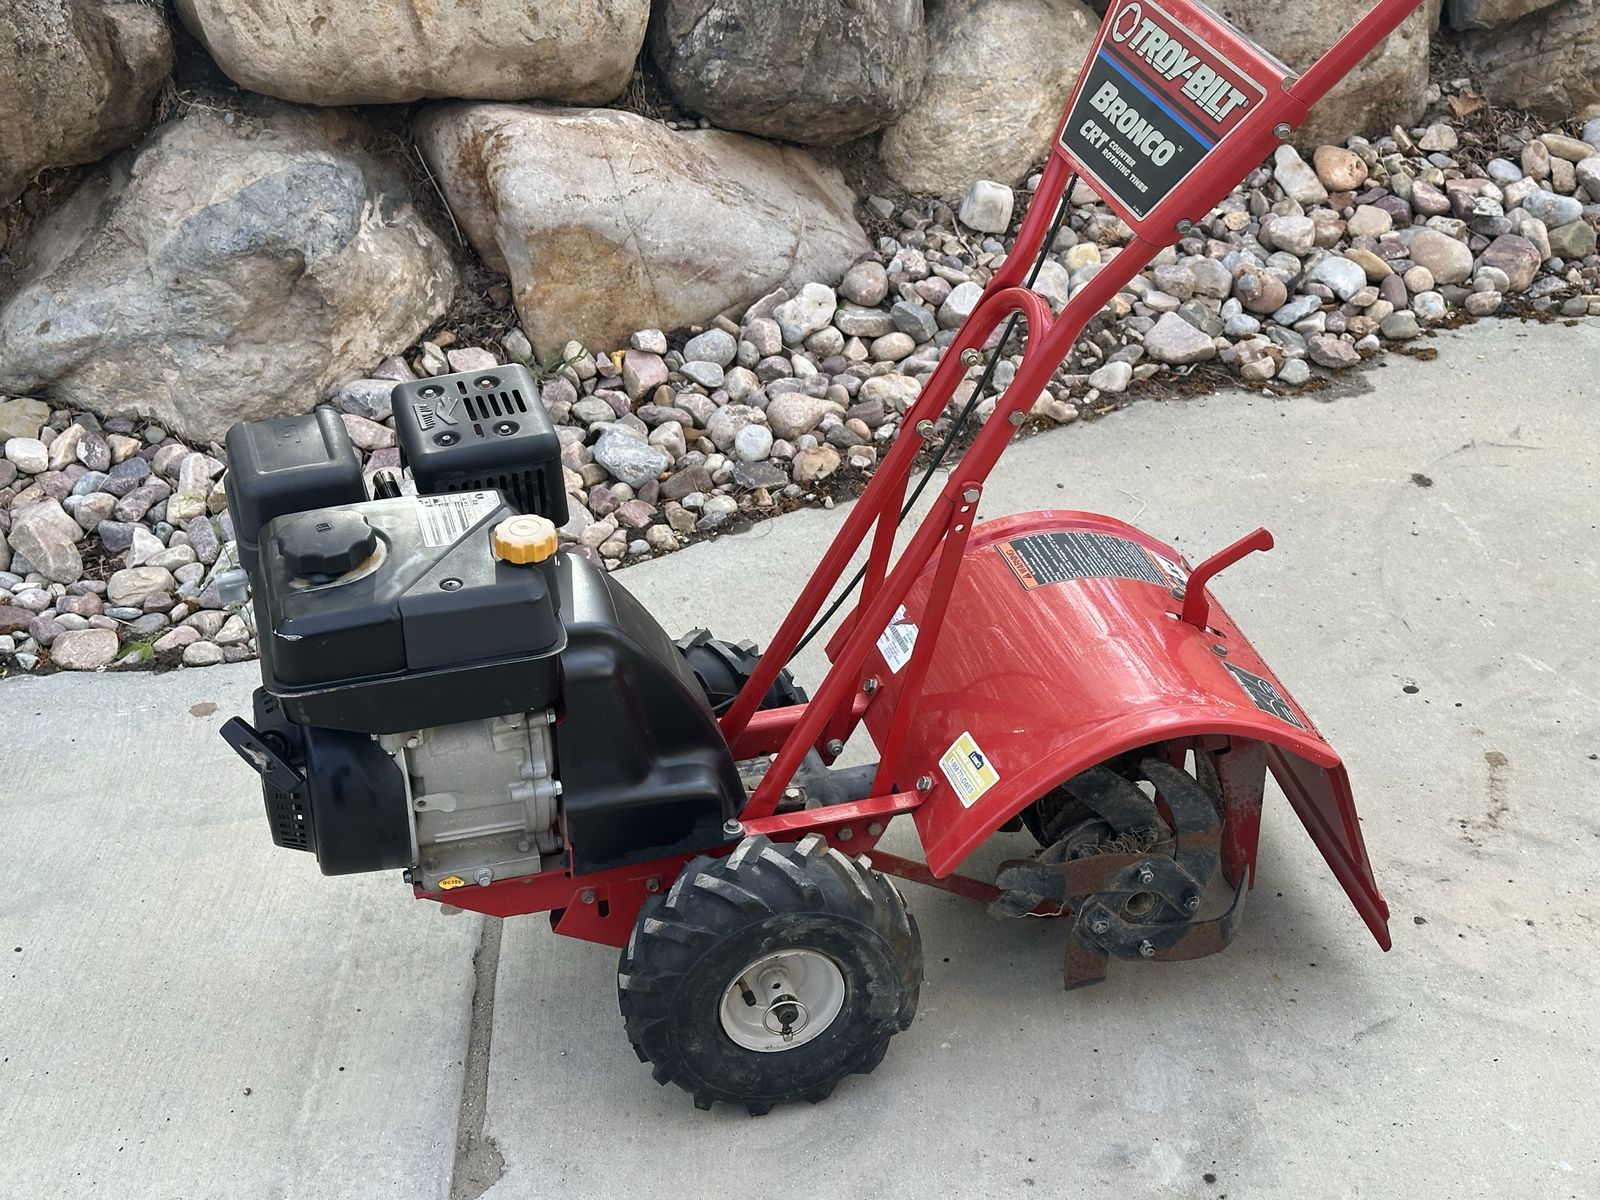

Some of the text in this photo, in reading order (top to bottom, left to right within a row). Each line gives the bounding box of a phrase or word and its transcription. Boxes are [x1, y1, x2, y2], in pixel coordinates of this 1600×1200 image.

[1128, 17, 1247, 123] TROY-BILT
[1079, 119, 1110, 149] CRT
[1089, 80, 1176, 167] BRONCO
[1101, 148, 1149, 193] ROTATING TINES
[1108, 140, 1136, 168] COUNTER
